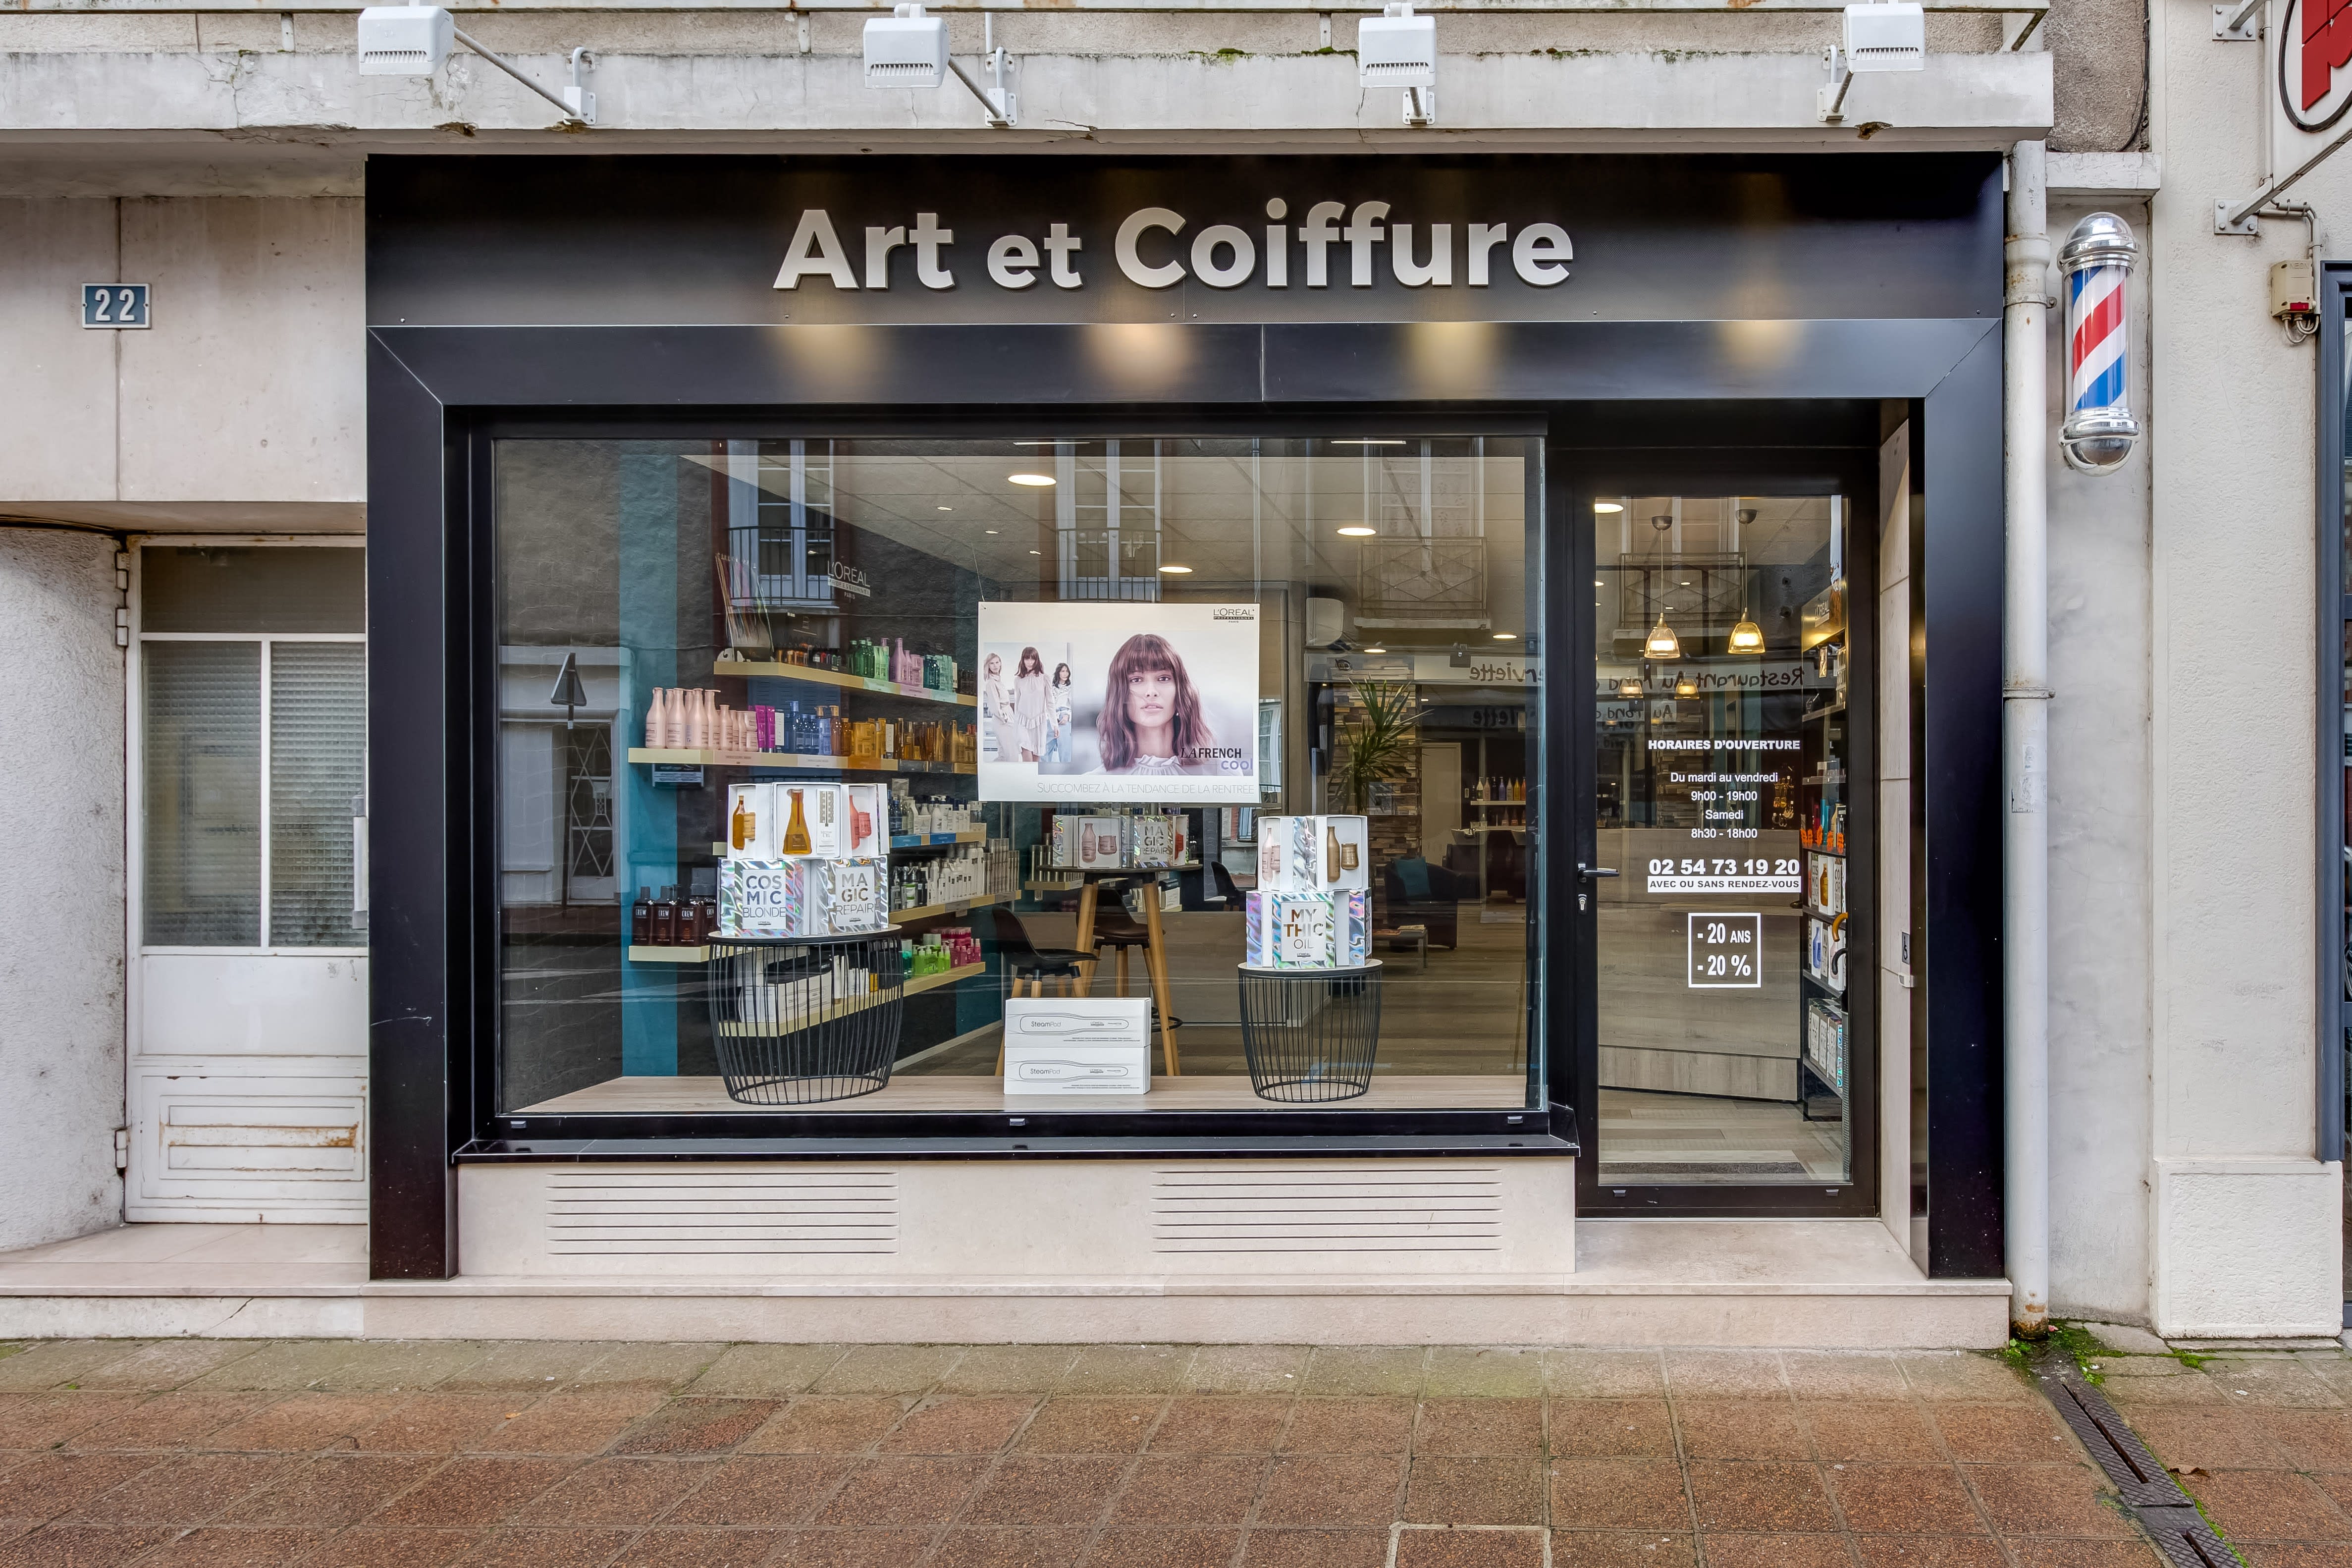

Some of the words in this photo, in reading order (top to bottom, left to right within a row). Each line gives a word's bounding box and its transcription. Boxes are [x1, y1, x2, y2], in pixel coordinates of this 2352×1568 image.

[772, 209, 957, 289] Art
[987, 222, 1083, 288] et
[1115, 197, 1574, 288] Coiffure
[95, 289, 135, 321] 22
[1648, 740, 1711, 750] HORAIRES
[1714, 740, 1800, 750] D'OUVERTURE
[1221, 758, 1253, 770] cool
[1670, 772, 1685, 782] Du
[1688, 772, 1716, 782] mardi
[1734, 772, 1778, 782] vendredi
[1037, 782, 1100, 794] SUCCOMBEZ
[1102, 781, 1111, 793] À
[1112, 784, 1124, 793] LA
[1126, 784, 1179, 794] TENDANCE
[1182, 784, 1196, 794] DE
[1198, 784, 1210, 794] LA
[1212, 783, 1254, 794] RENTRÉE
[1691, 791, 1716, 801] 9h00
[1726, 791, 1758, 801] 19h00
[1705, 809, 1743, 820] Samedi
[1691, 828, 1716, 838] 8h30
[1726, 828, 1758, 838] 18h00
[1649, 859, 1674, 875] 02
[1680, 859, 1706, 875] 54
[1712, 859, 1737, 875] 73
[1744, 859, 1768, 875] 19
[1774, 859, 1800, 875] 20
[746, 875, 782, 890] COS
[842, 873, 868, 887] MA
[747, 891, 782, 905] MIC
[841, 887, 868, 902] GIC
[743, 907, 786, 918] BLONDE
[836, 903, 874, 916] REPAIR
[1291, 909, 1318, 922] MY
[1283, 923, 1324, 937] THIC
[1707, 923, 1726, 944] 20
[1730, 930, 1751, 943] ANS
[1293, 939, 1314, 949] OIL
[1707, 955, 1726, 975] 20
[1731, 954, 1751, 976] %
